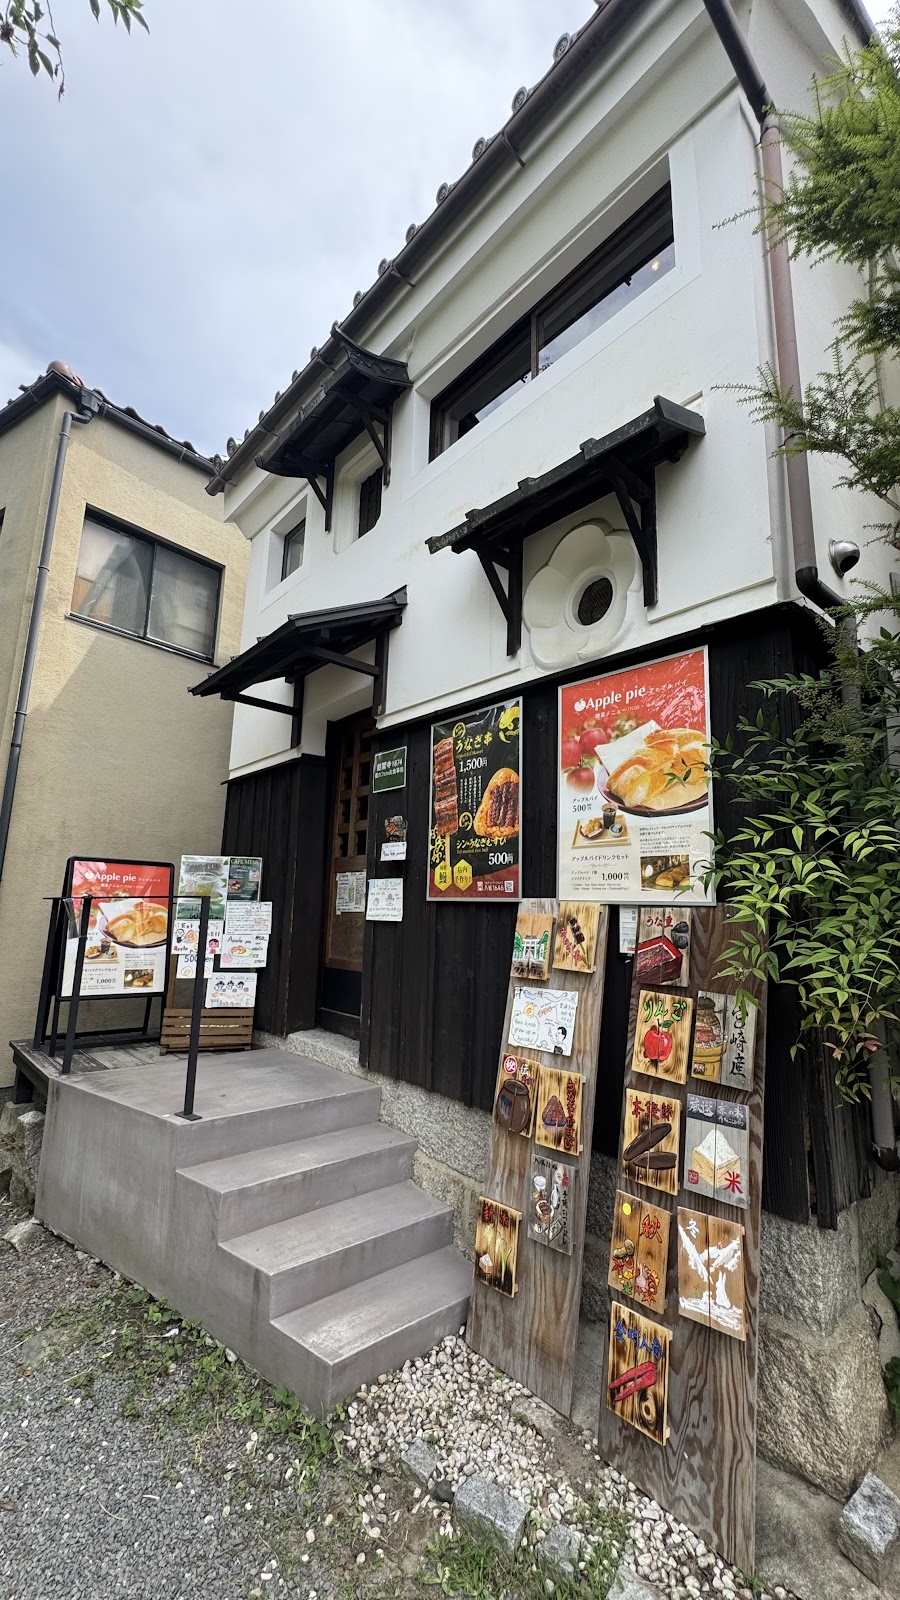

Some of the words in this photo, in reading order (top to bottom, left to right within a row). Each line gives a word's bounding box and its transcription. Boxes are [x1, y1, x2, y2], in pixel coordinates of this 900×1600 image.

[586, 690, 622, 711] Apple
[625, 685, 646, 704] pie
[455, 731, 493, 754] うなぎ串
[572, 795, 598, 804] アップルパイ
[571, 854, 630, 862] アップルパイドリンクセット
[94, 872, 121, 883] Apple
[122, 873, 137, 883] pie
[646, 915, 674, 928] うな重
[643, 999, 687, 1023] りんご
[722, 1170, 744, 1194] 米
[639, 1213, 663, 1244] 秋
[685, 1218, 700, 1239] 冬
